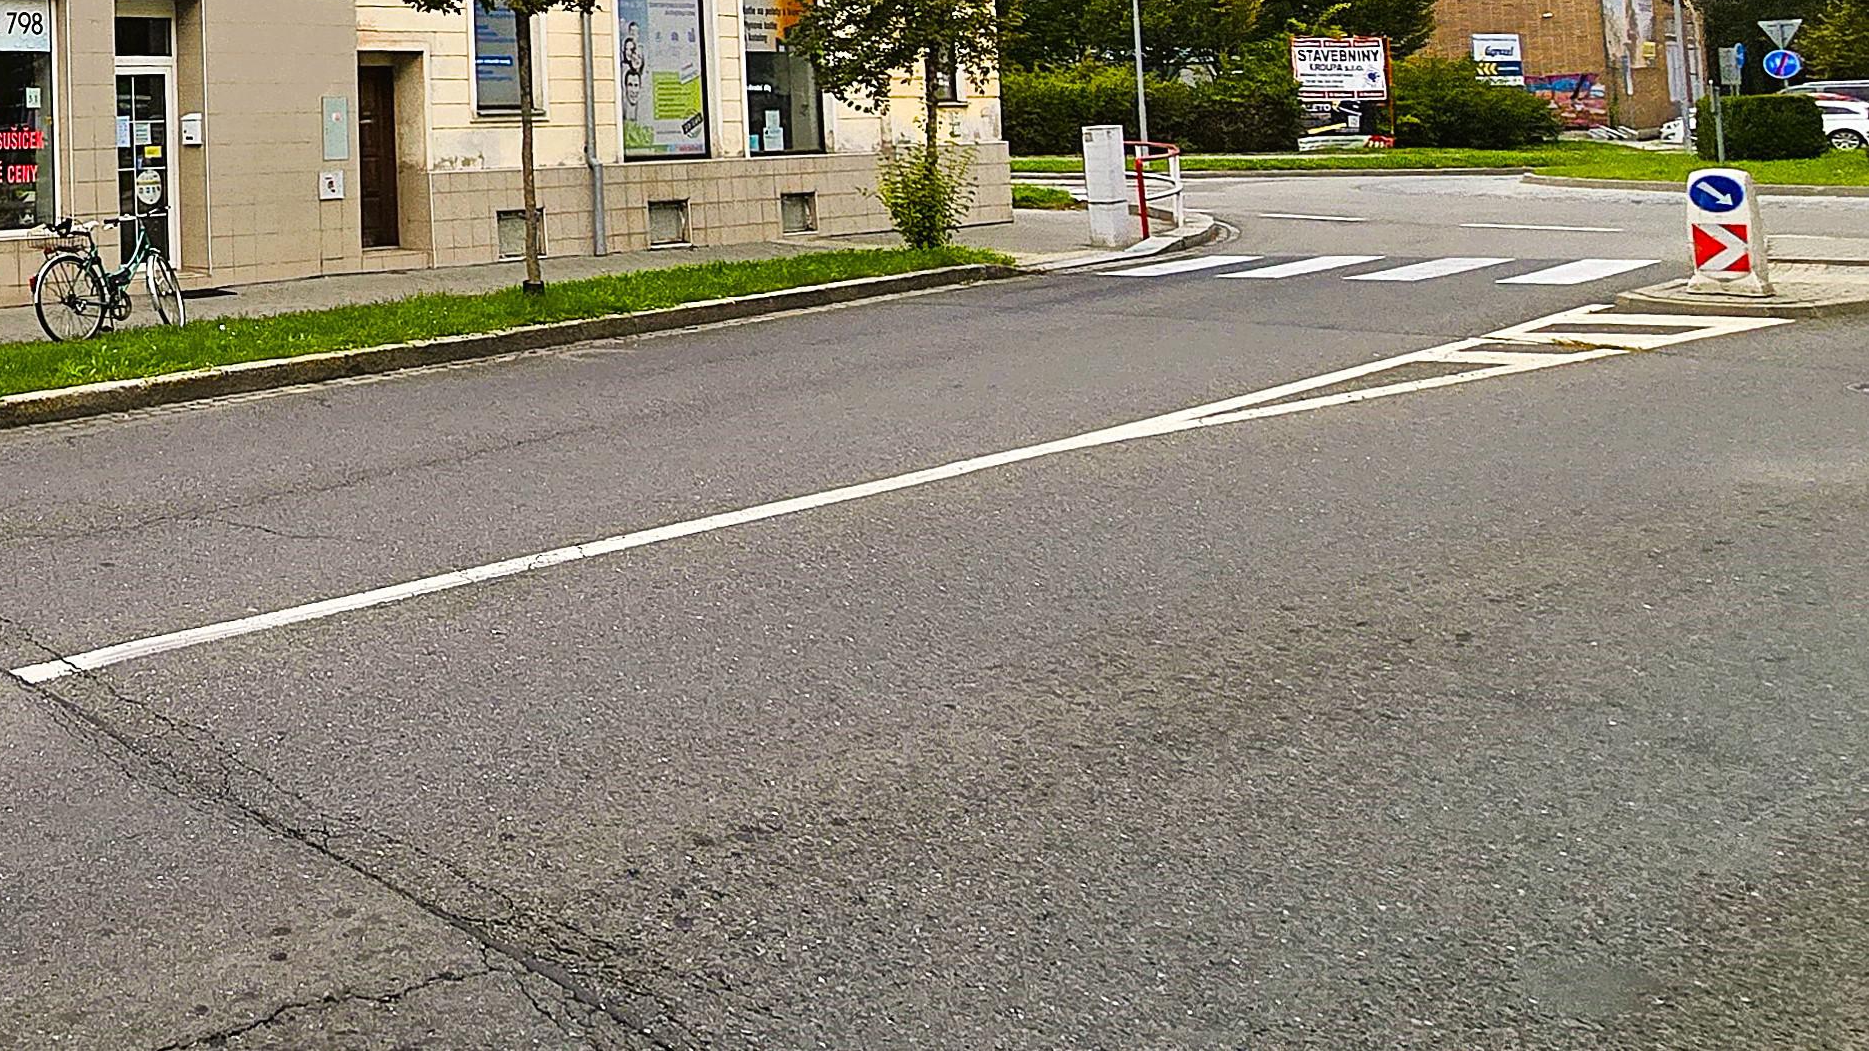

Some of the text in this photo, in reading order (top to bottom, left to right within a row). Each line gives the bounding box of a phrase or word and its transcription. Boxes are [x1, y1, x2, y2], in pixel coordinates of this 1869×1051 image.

[6, 11, 44, 36] 798
[1297, 49, 1379, 62] STAVEBNINY
[7, 164, 39, 183] CENY
